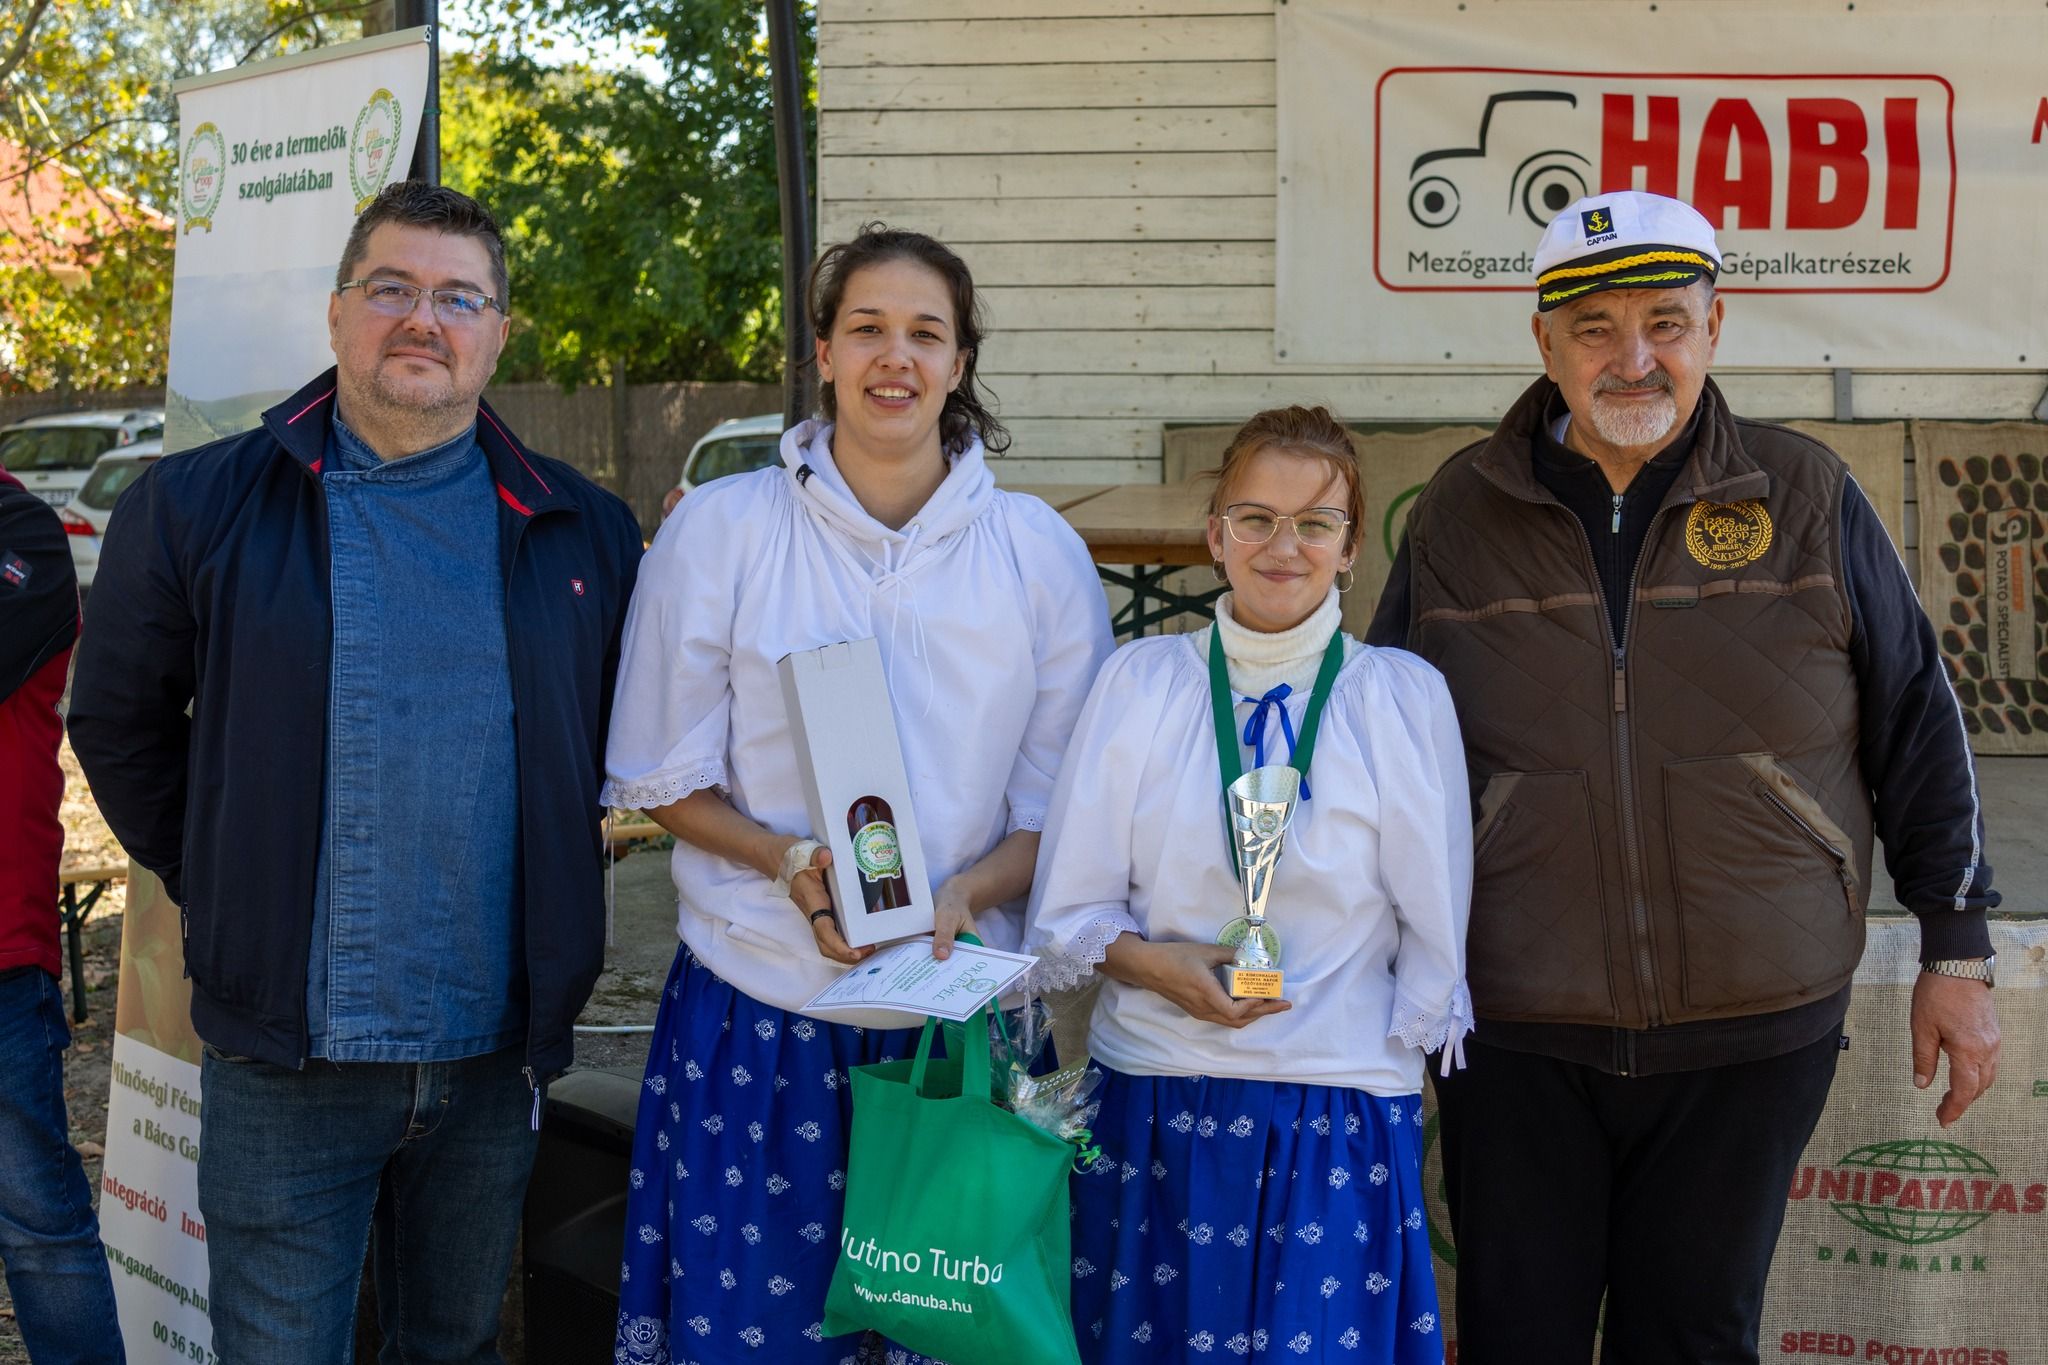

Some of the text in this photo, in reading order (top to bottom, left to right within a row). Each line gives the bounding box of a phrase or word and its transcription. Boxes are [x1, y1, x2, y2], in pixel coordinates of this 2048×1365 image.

[231, 142, 247, 165] 30
[250, 139, 272, 163] éve
[275, 141, 283, 158] a
[286, 125, 347, 157] termelők
[1600, 93, 1921, 230] HABI
[239, 168, 333, 202] szolgálatában
[1587, 232, 1618, 247] CAPTAIN
[1720, 247, 1912, 281] Gépalkatrészek
[1713, 543, 1743, 551] HUNGARY
[1996, 550, 2011, 679] POTATO SPECIALIST
[133, 1118, 141, 1136] a
[144, 1117, 176, 1152] Bács
[103, 1170, 167, 1222] Integráció
[1787, 1166, 2047, 1214] UNIPATATAS
[929, 1247, 1003, 1285] Turbo
[1817, 1245, 1988, 1273] DANMARK
[854, 1282, 973, 1314] www.danuba.hu
[153, 1320, 168, 1343] 00
[170, 1330, 186, 1353] 36
[188, 1341, 204, 1364] 30
[1780, 1330, 2010, 1365] SEED POTATOES
